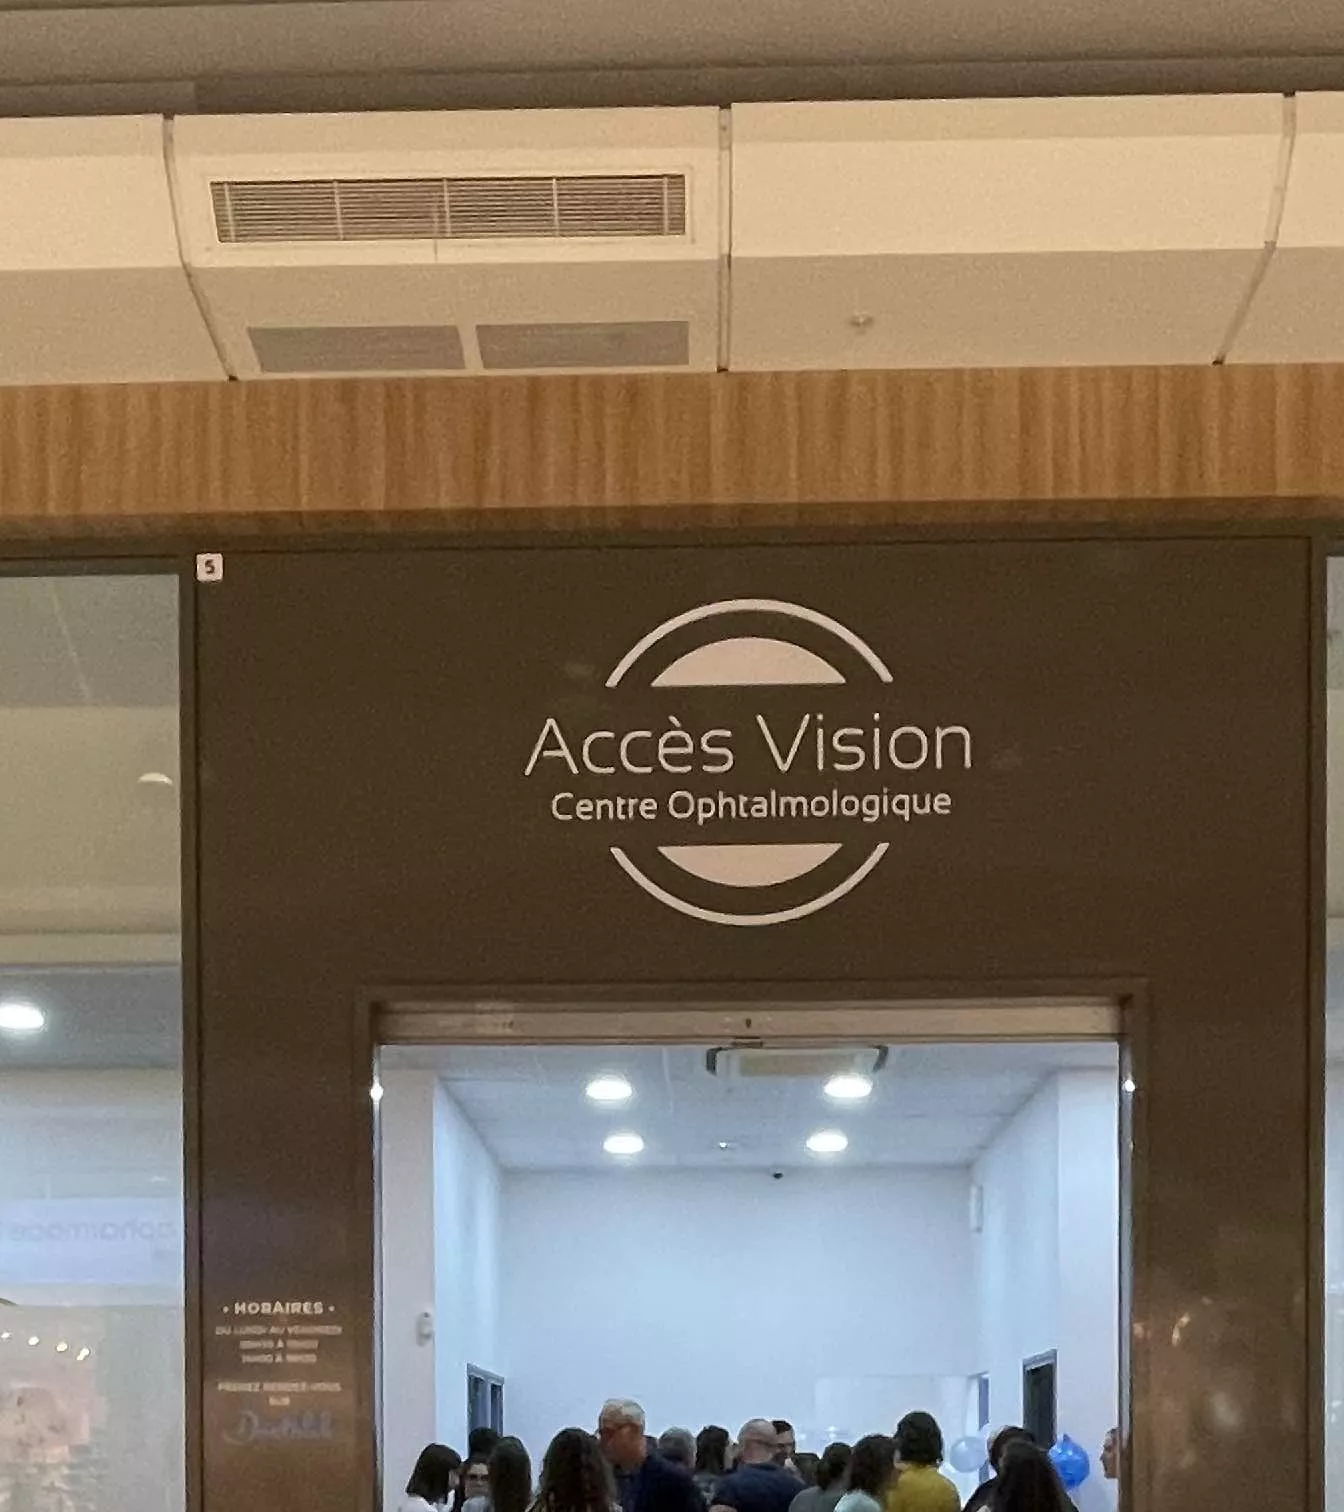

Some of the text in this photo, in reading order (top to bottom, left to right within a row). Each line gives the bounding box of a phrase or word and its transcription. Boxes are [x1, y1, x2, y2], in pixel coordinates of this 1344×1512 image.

[524, 712, 973, 776] Accès Vision
[551, 787, 953, 827] Centre Ophtalmologique
[234, 1301, 324, 1314] HORAIRES
